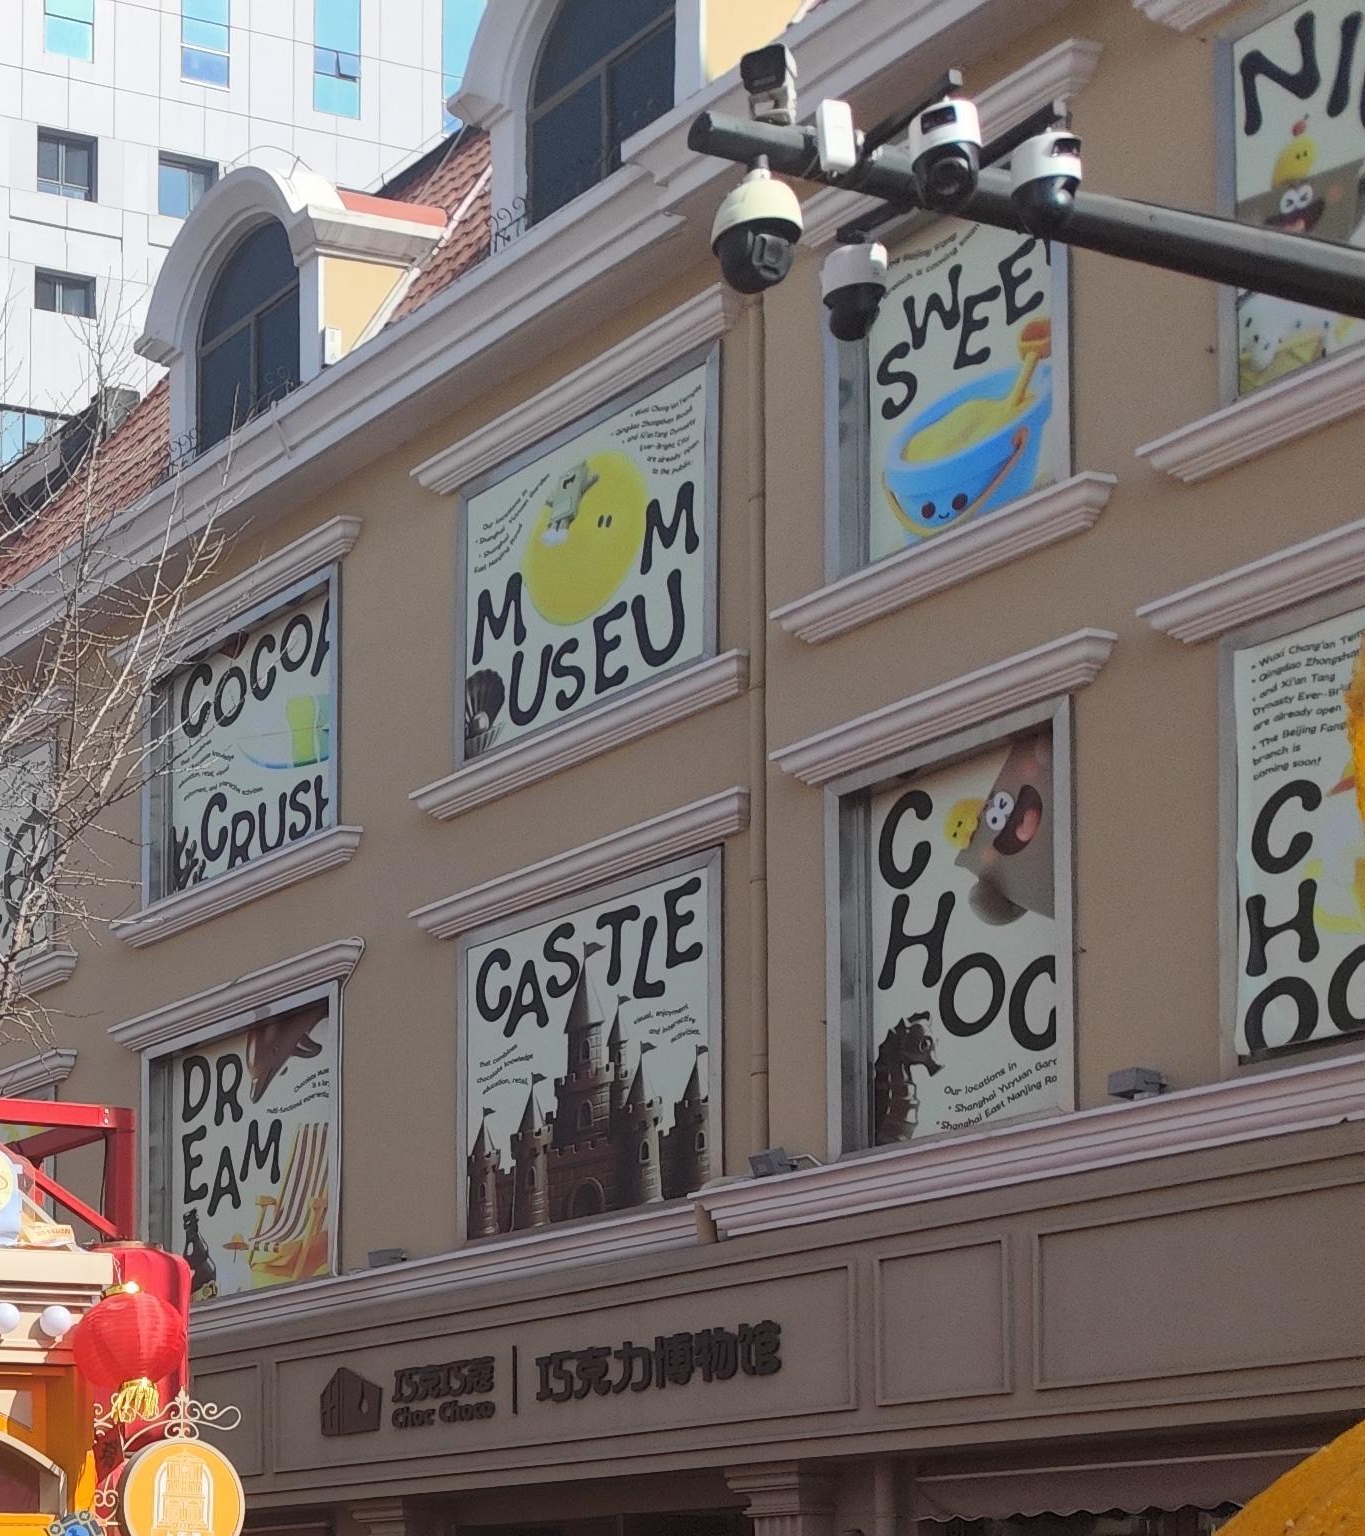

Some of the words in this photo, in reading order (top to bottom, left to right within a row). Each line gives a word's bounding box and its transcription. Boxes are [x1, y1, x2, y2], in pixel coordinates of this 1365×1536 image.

[1240, 10, 1365, 136] NI
[1259, 683, 1278, 698] and
[1253, 718, 1269, 731] are
[1273, 707, 1311, 722] already
[1316, 705, 1341, 716] open
[1282, 725, 1316, 740] Beijing
[1293, 744, 1301, 752] is
[1253, 762, 1289, 781] coming
[475, 876, 703, 1039] CASTLE
[944, 1085, 962, 1096] Our
[965, 1068, 1005, 1094] locations
[1008, 1062, 1018, 1071] in
[955, 1090, 997, 1113] Shanghai
[998, 1068, 1032, 1093] Yuyuan
[985, 1101, 1005, 1117] East
[1007, 1082, 1042, 1104] Nanjing
[535, 1320, 782, 1404] 巧克力博物馆
[391, 1406, 436, 1428] Choc
